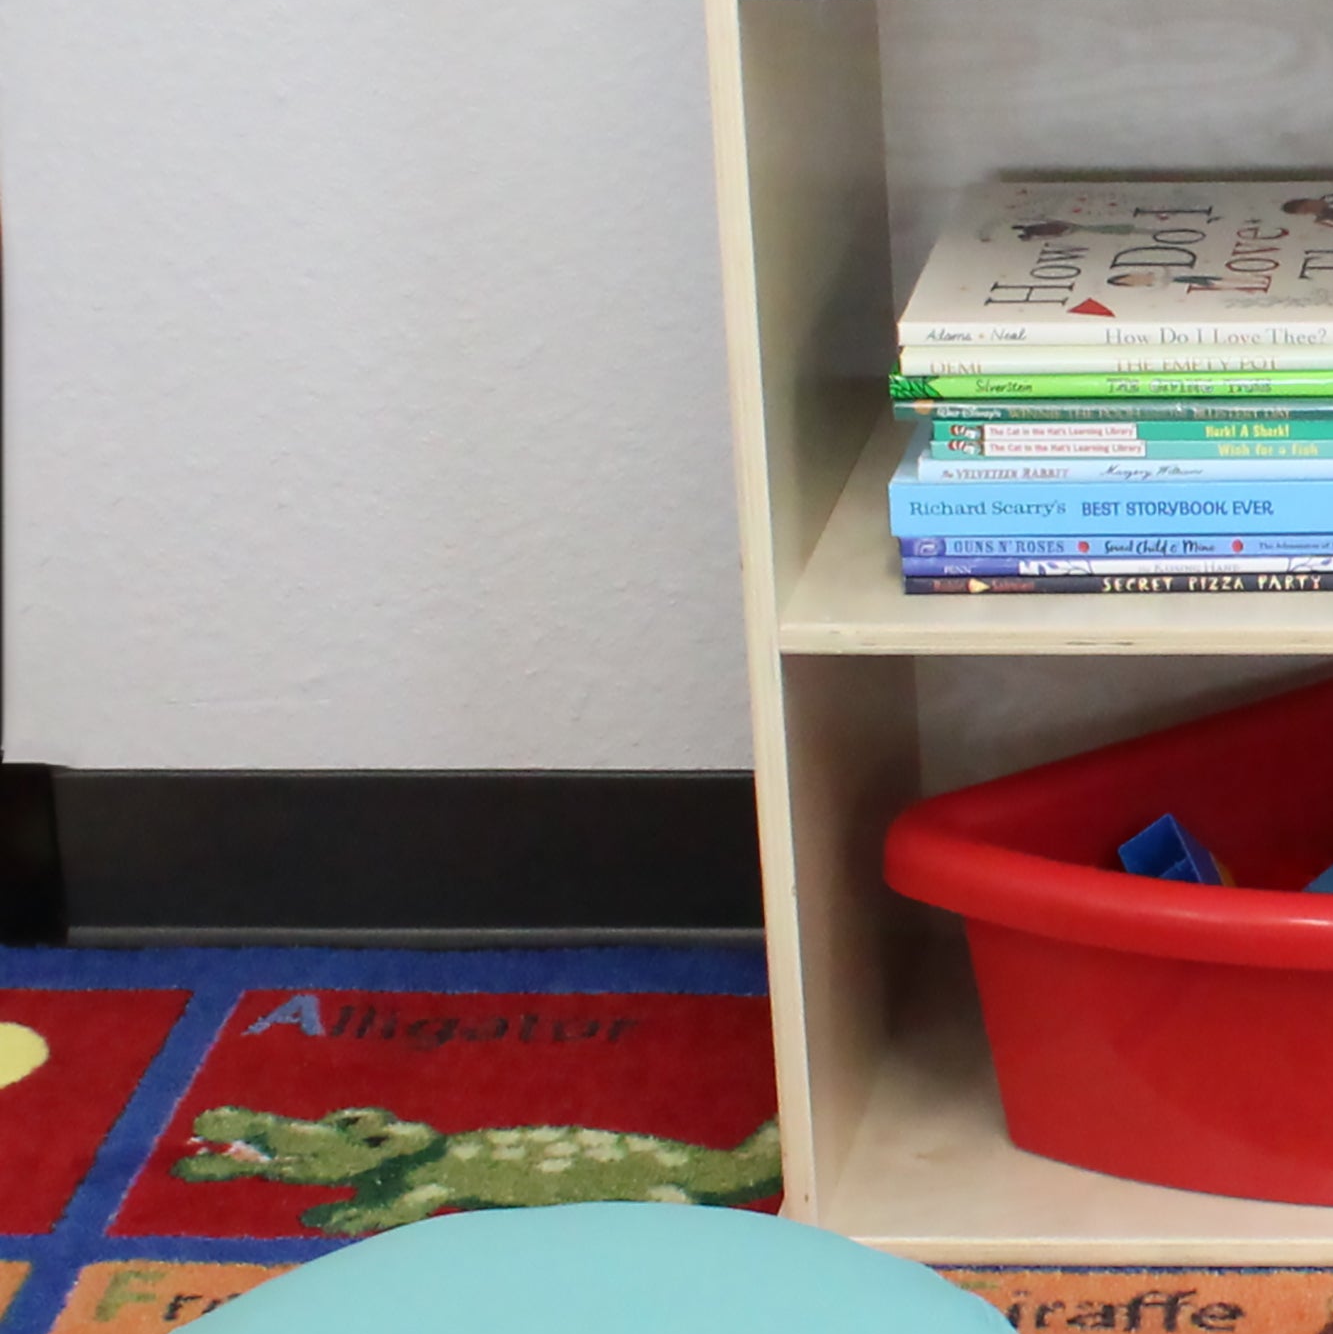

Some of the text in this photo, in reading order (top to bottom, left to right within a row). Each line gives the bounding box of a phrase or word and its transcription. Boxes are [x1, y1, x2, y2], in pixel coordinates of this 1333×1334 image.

[1109, 229, 1206, 269] Do
[1185, 222, 1290, 295] Love
[983, 242, 1090, 307] How
[926, 327, 1027, 342] Adams Neal
[1105, 326, 1328, 346] How Do I Love Thee?
[974, 378, 1034, 394] Silverstein
[1239, 424, 1249, 437] A
[909, 500, 1067, 517] Richard Scarry's
[1081, 499, 1275, 517] BEST STORYBOOK EVER
[953, 540, 994, 554] GUNS
[1016, 539, 1065, 553] ROSES
[1102, 574, 1322, 593] SECRET PIZZA PARTY
[240, 994, 640, 1052] Alligator
